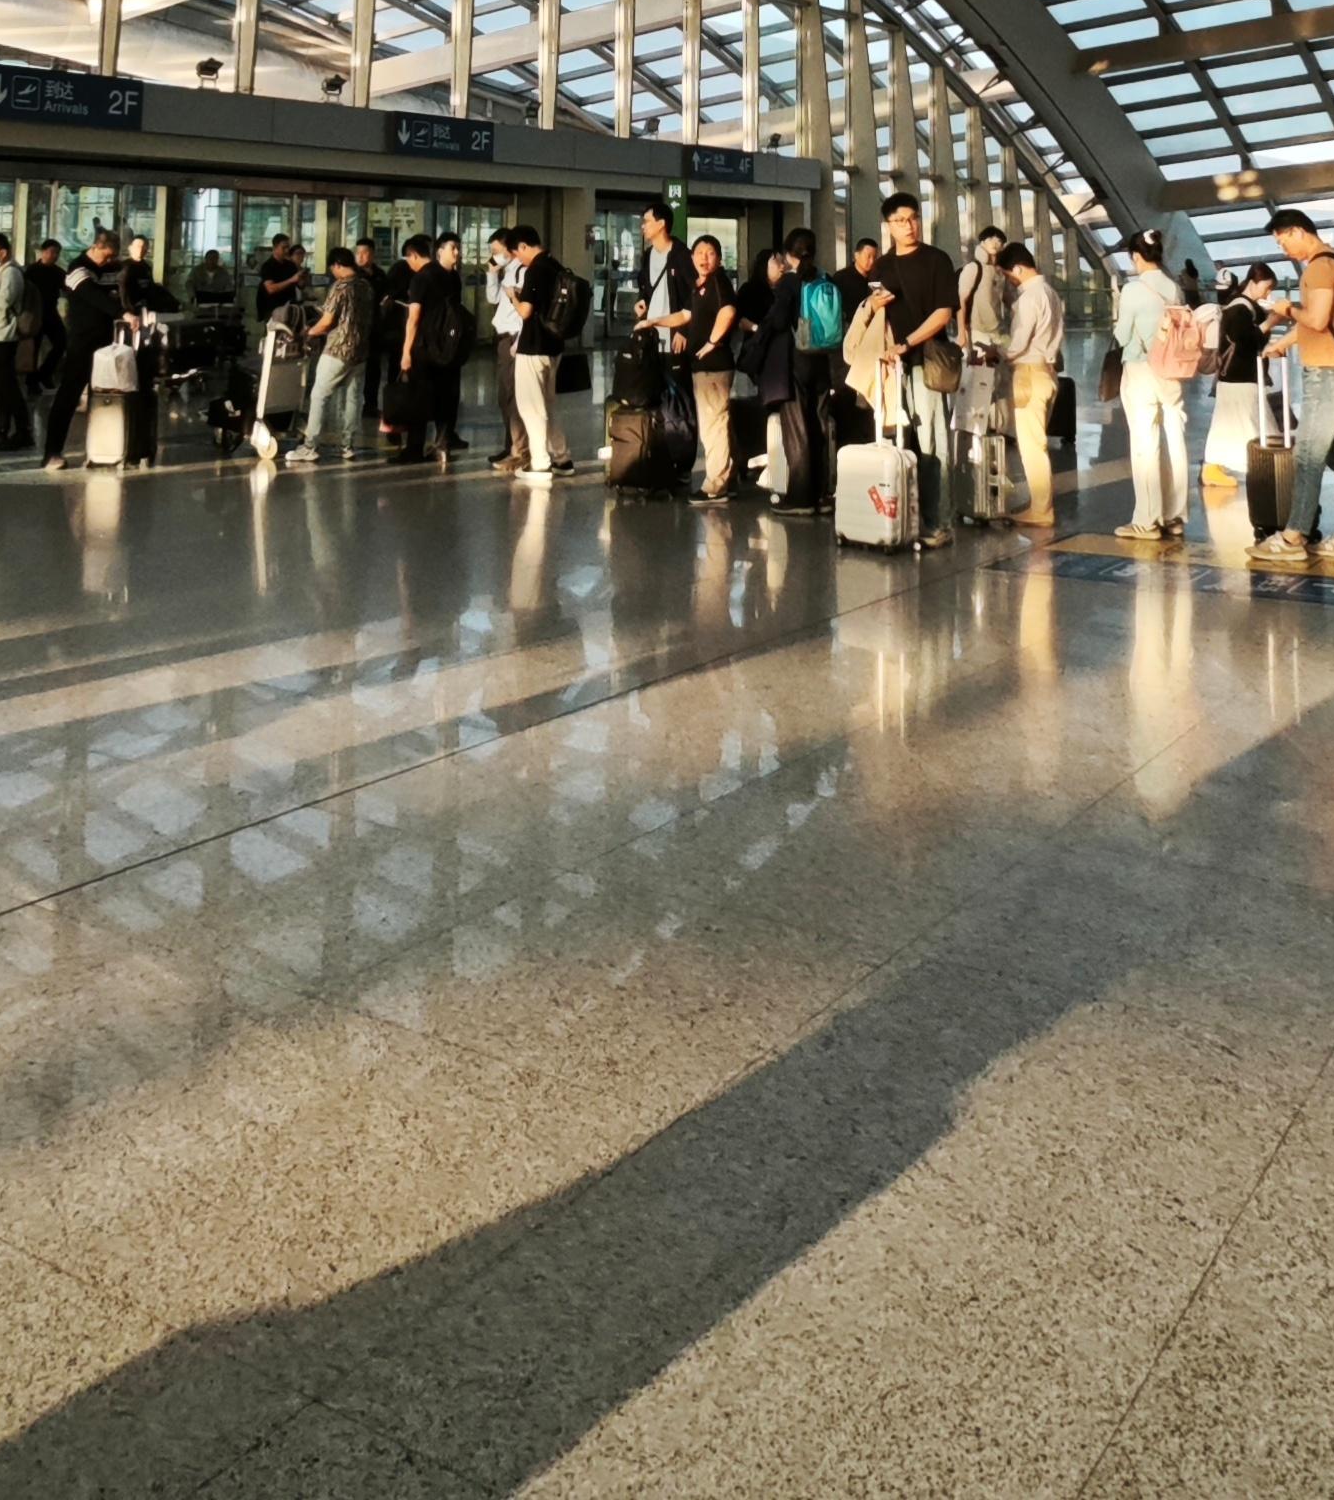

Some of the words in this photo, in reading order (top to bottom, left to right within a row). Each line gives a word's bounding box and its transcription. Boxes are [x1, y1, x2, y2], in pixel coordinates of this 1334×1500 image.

[44, 79, 74, 101] 到达
[43, 100, 89, 116] Arrivals
[108, 90, 140, 115] 2F
[471, 131, 491, 151] 2F
